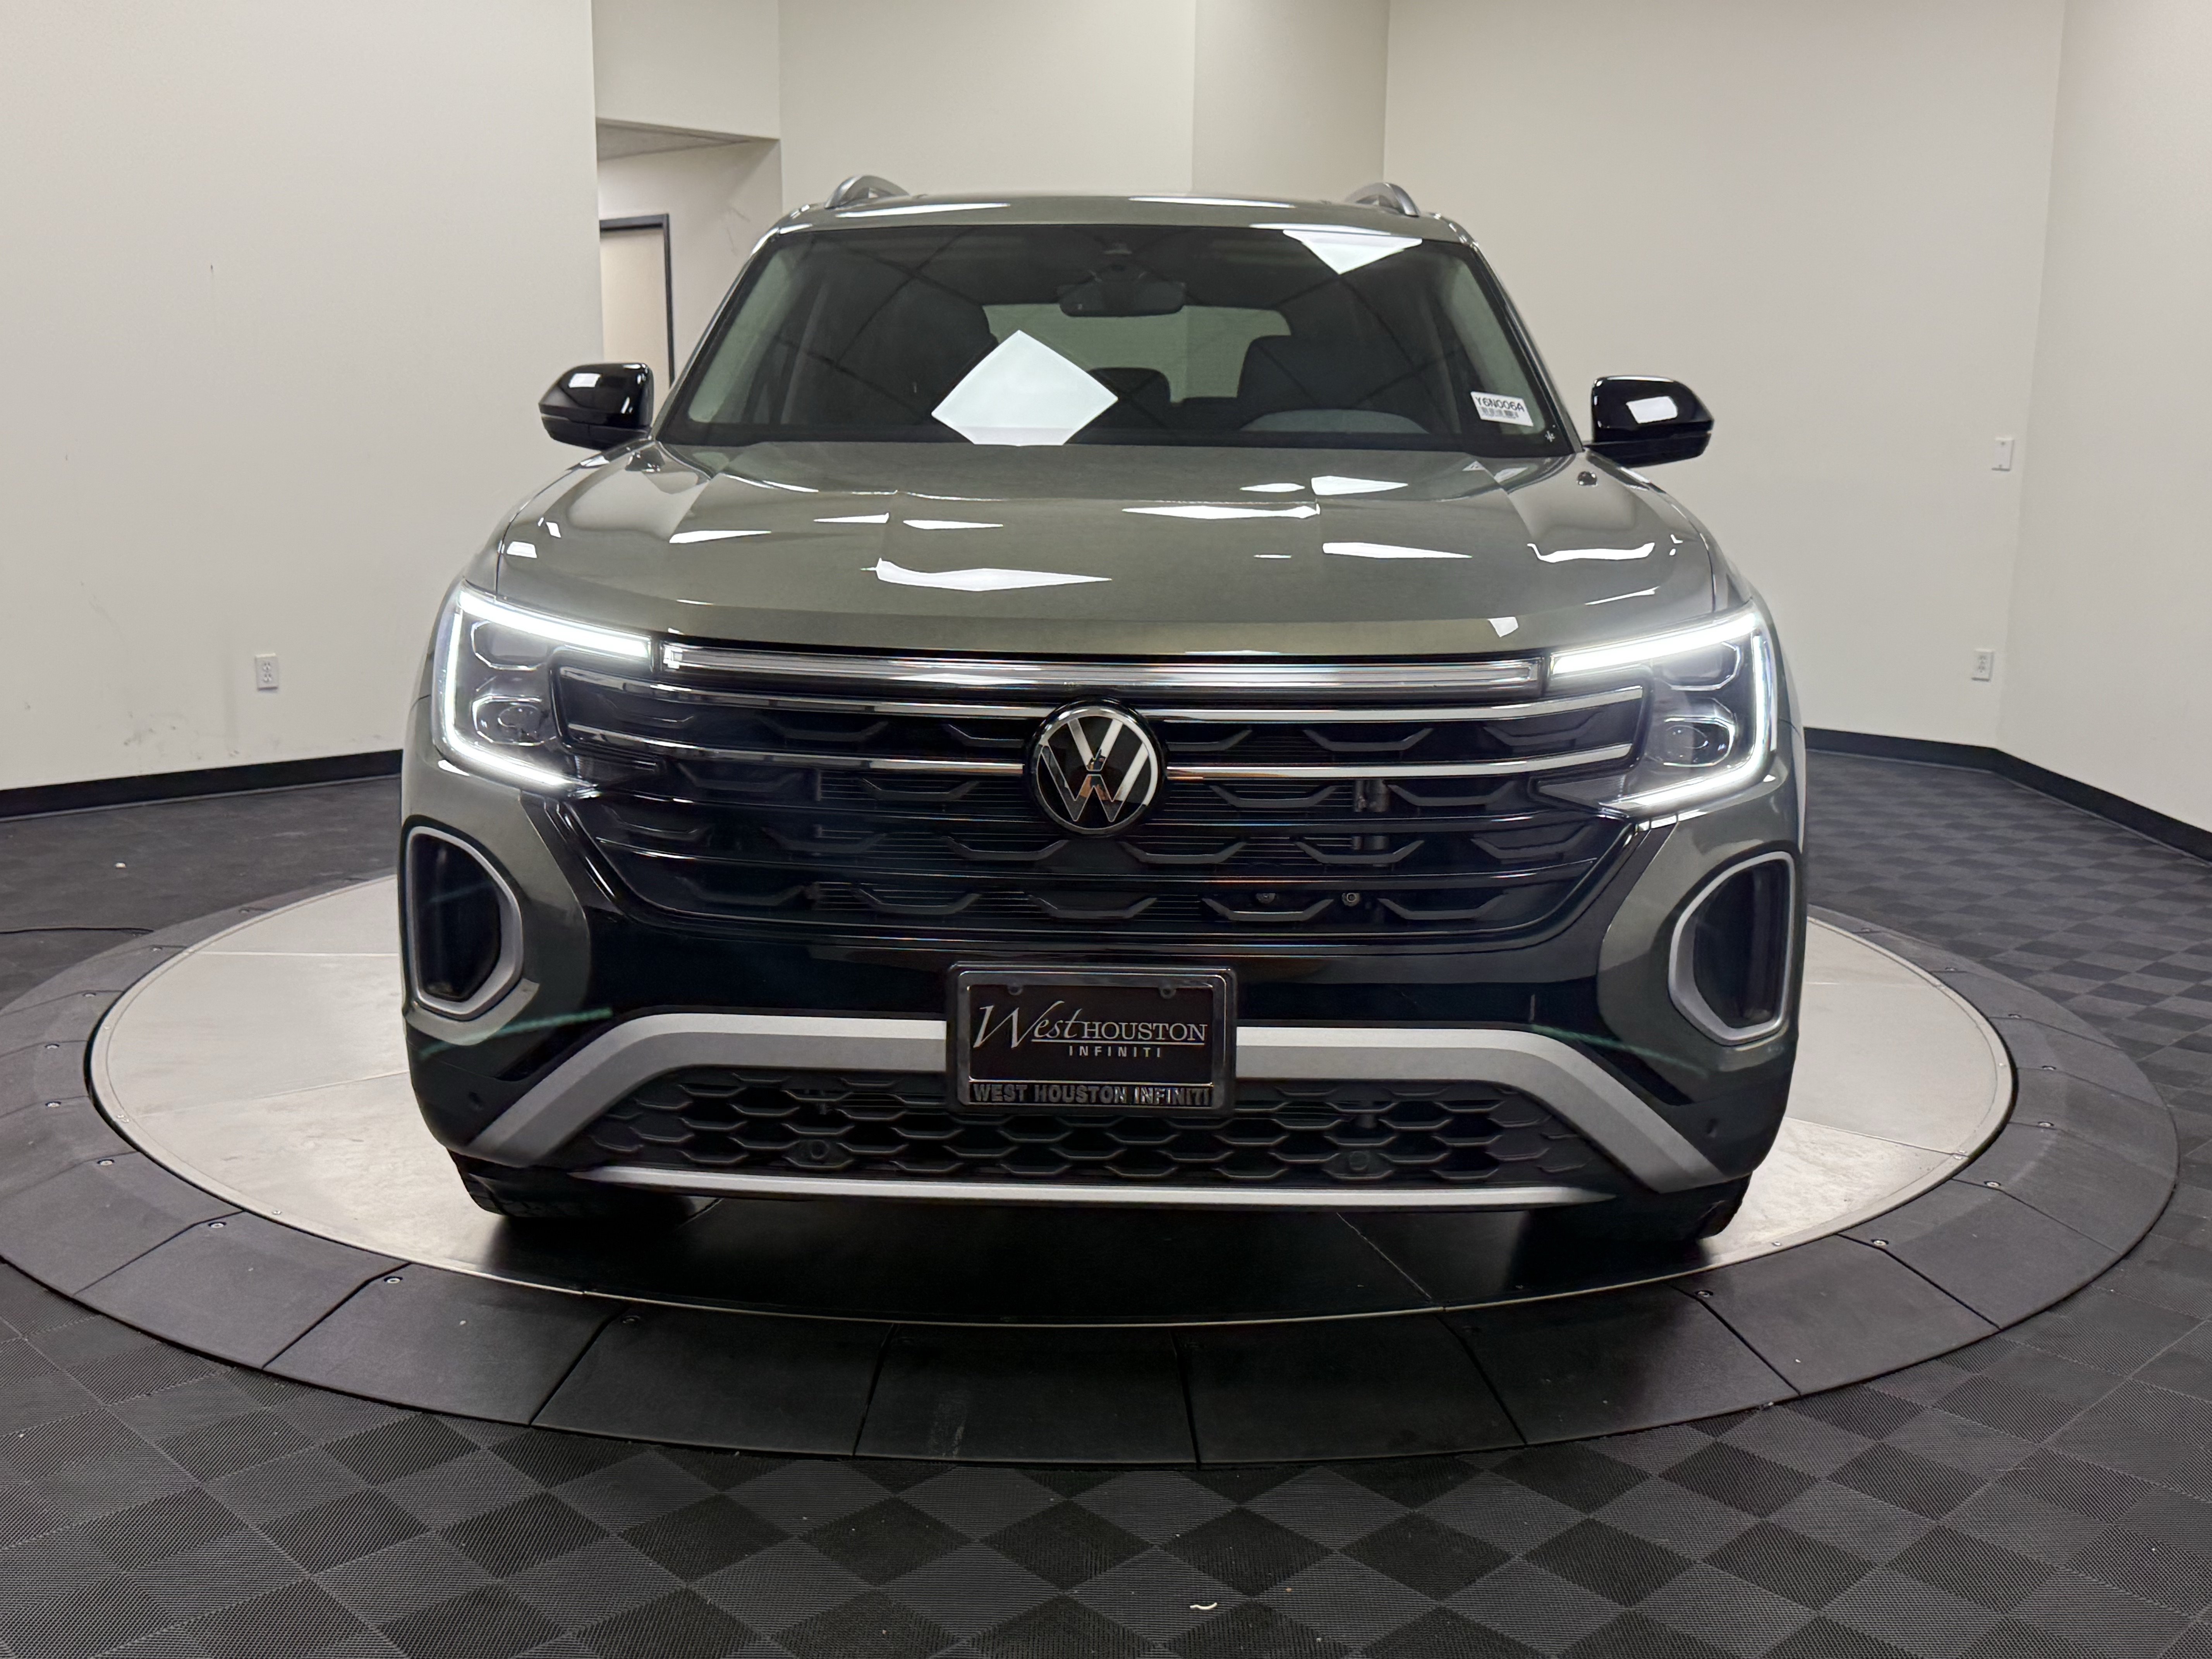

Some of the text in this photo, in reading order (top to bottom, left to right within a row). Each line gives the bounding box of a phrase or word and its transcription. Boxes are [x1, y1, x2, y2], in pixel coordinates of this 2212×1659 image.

[973, 1000, 1208, 1049] West HOUSTON
[1069, 1045, 1161, 1058] INFINITI
[973, 1084, 1210, 1106] WEST HOUSTON INFINITI
